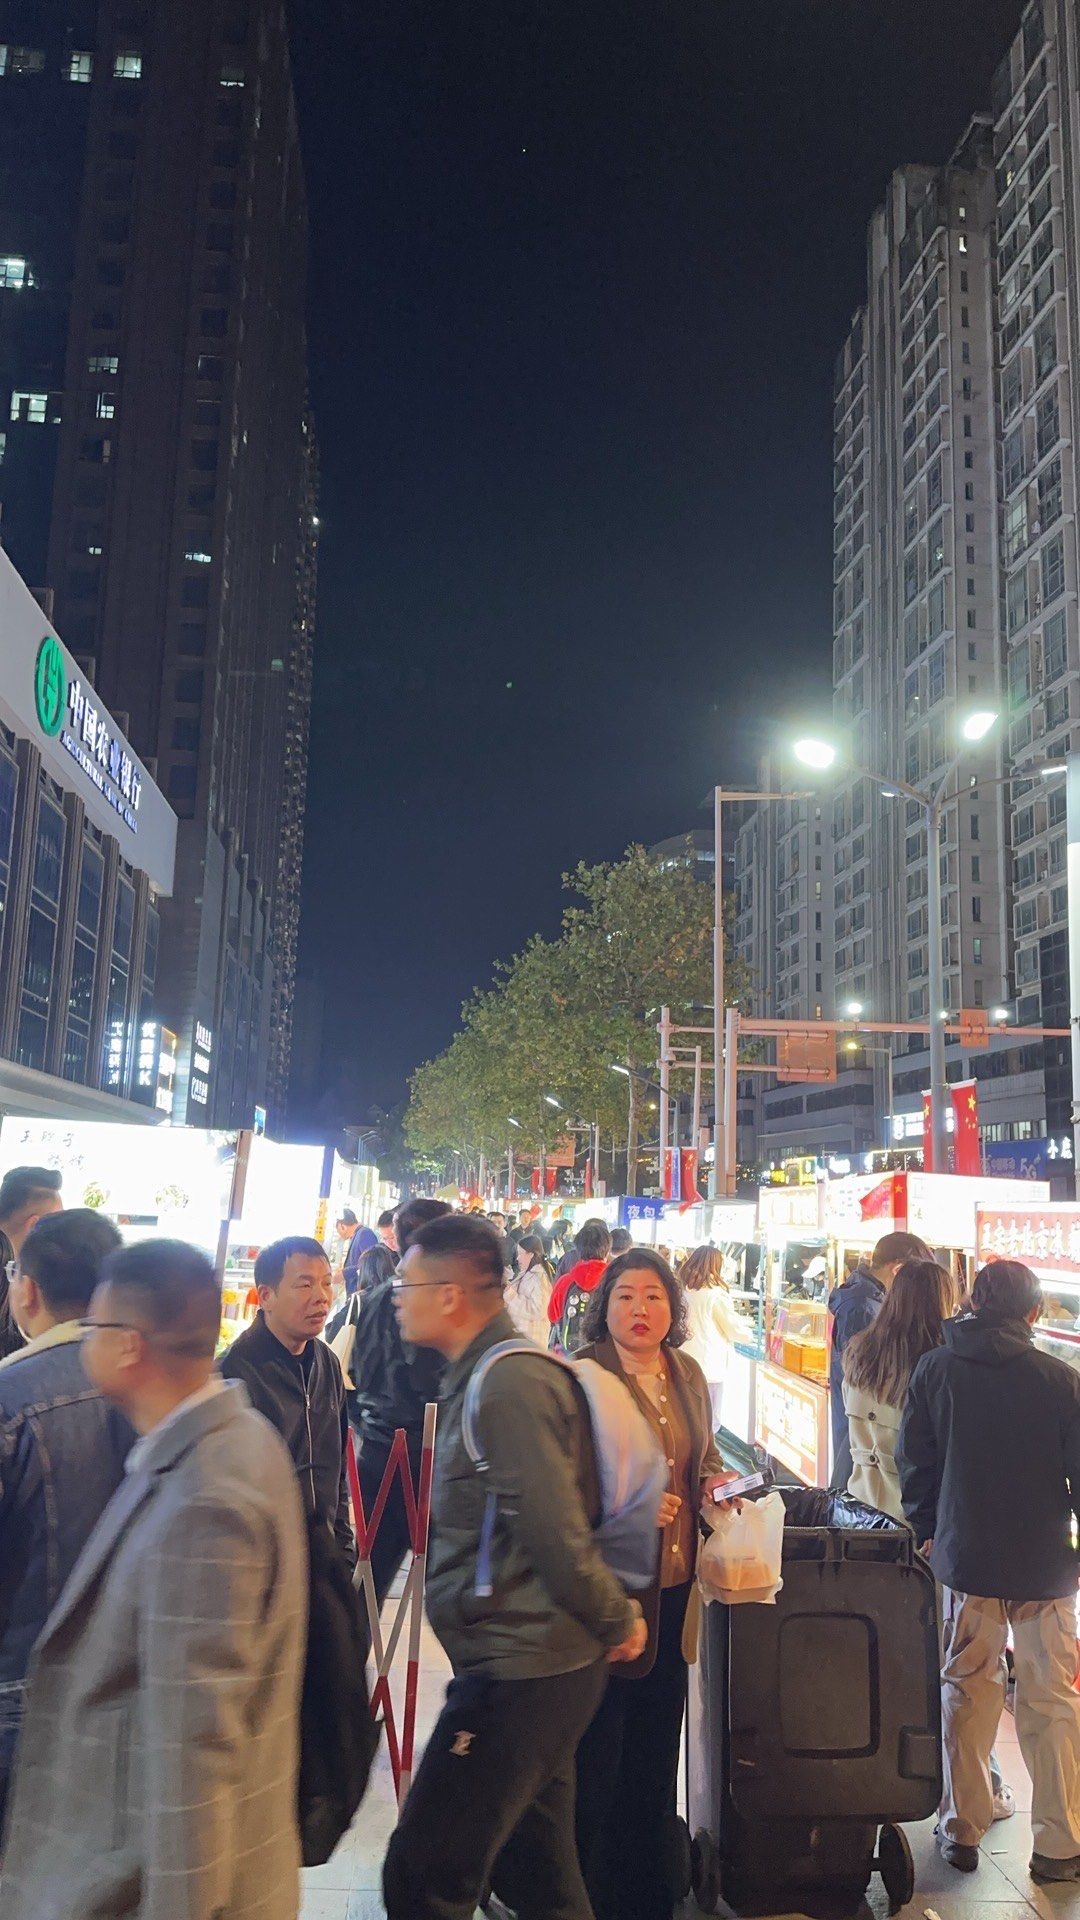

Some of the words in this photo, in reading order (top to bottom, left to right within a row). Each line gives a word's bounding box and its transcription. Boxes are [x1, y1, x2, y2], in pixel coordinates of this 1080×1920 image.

[69, 680, 141, 811] 中国农业银行
